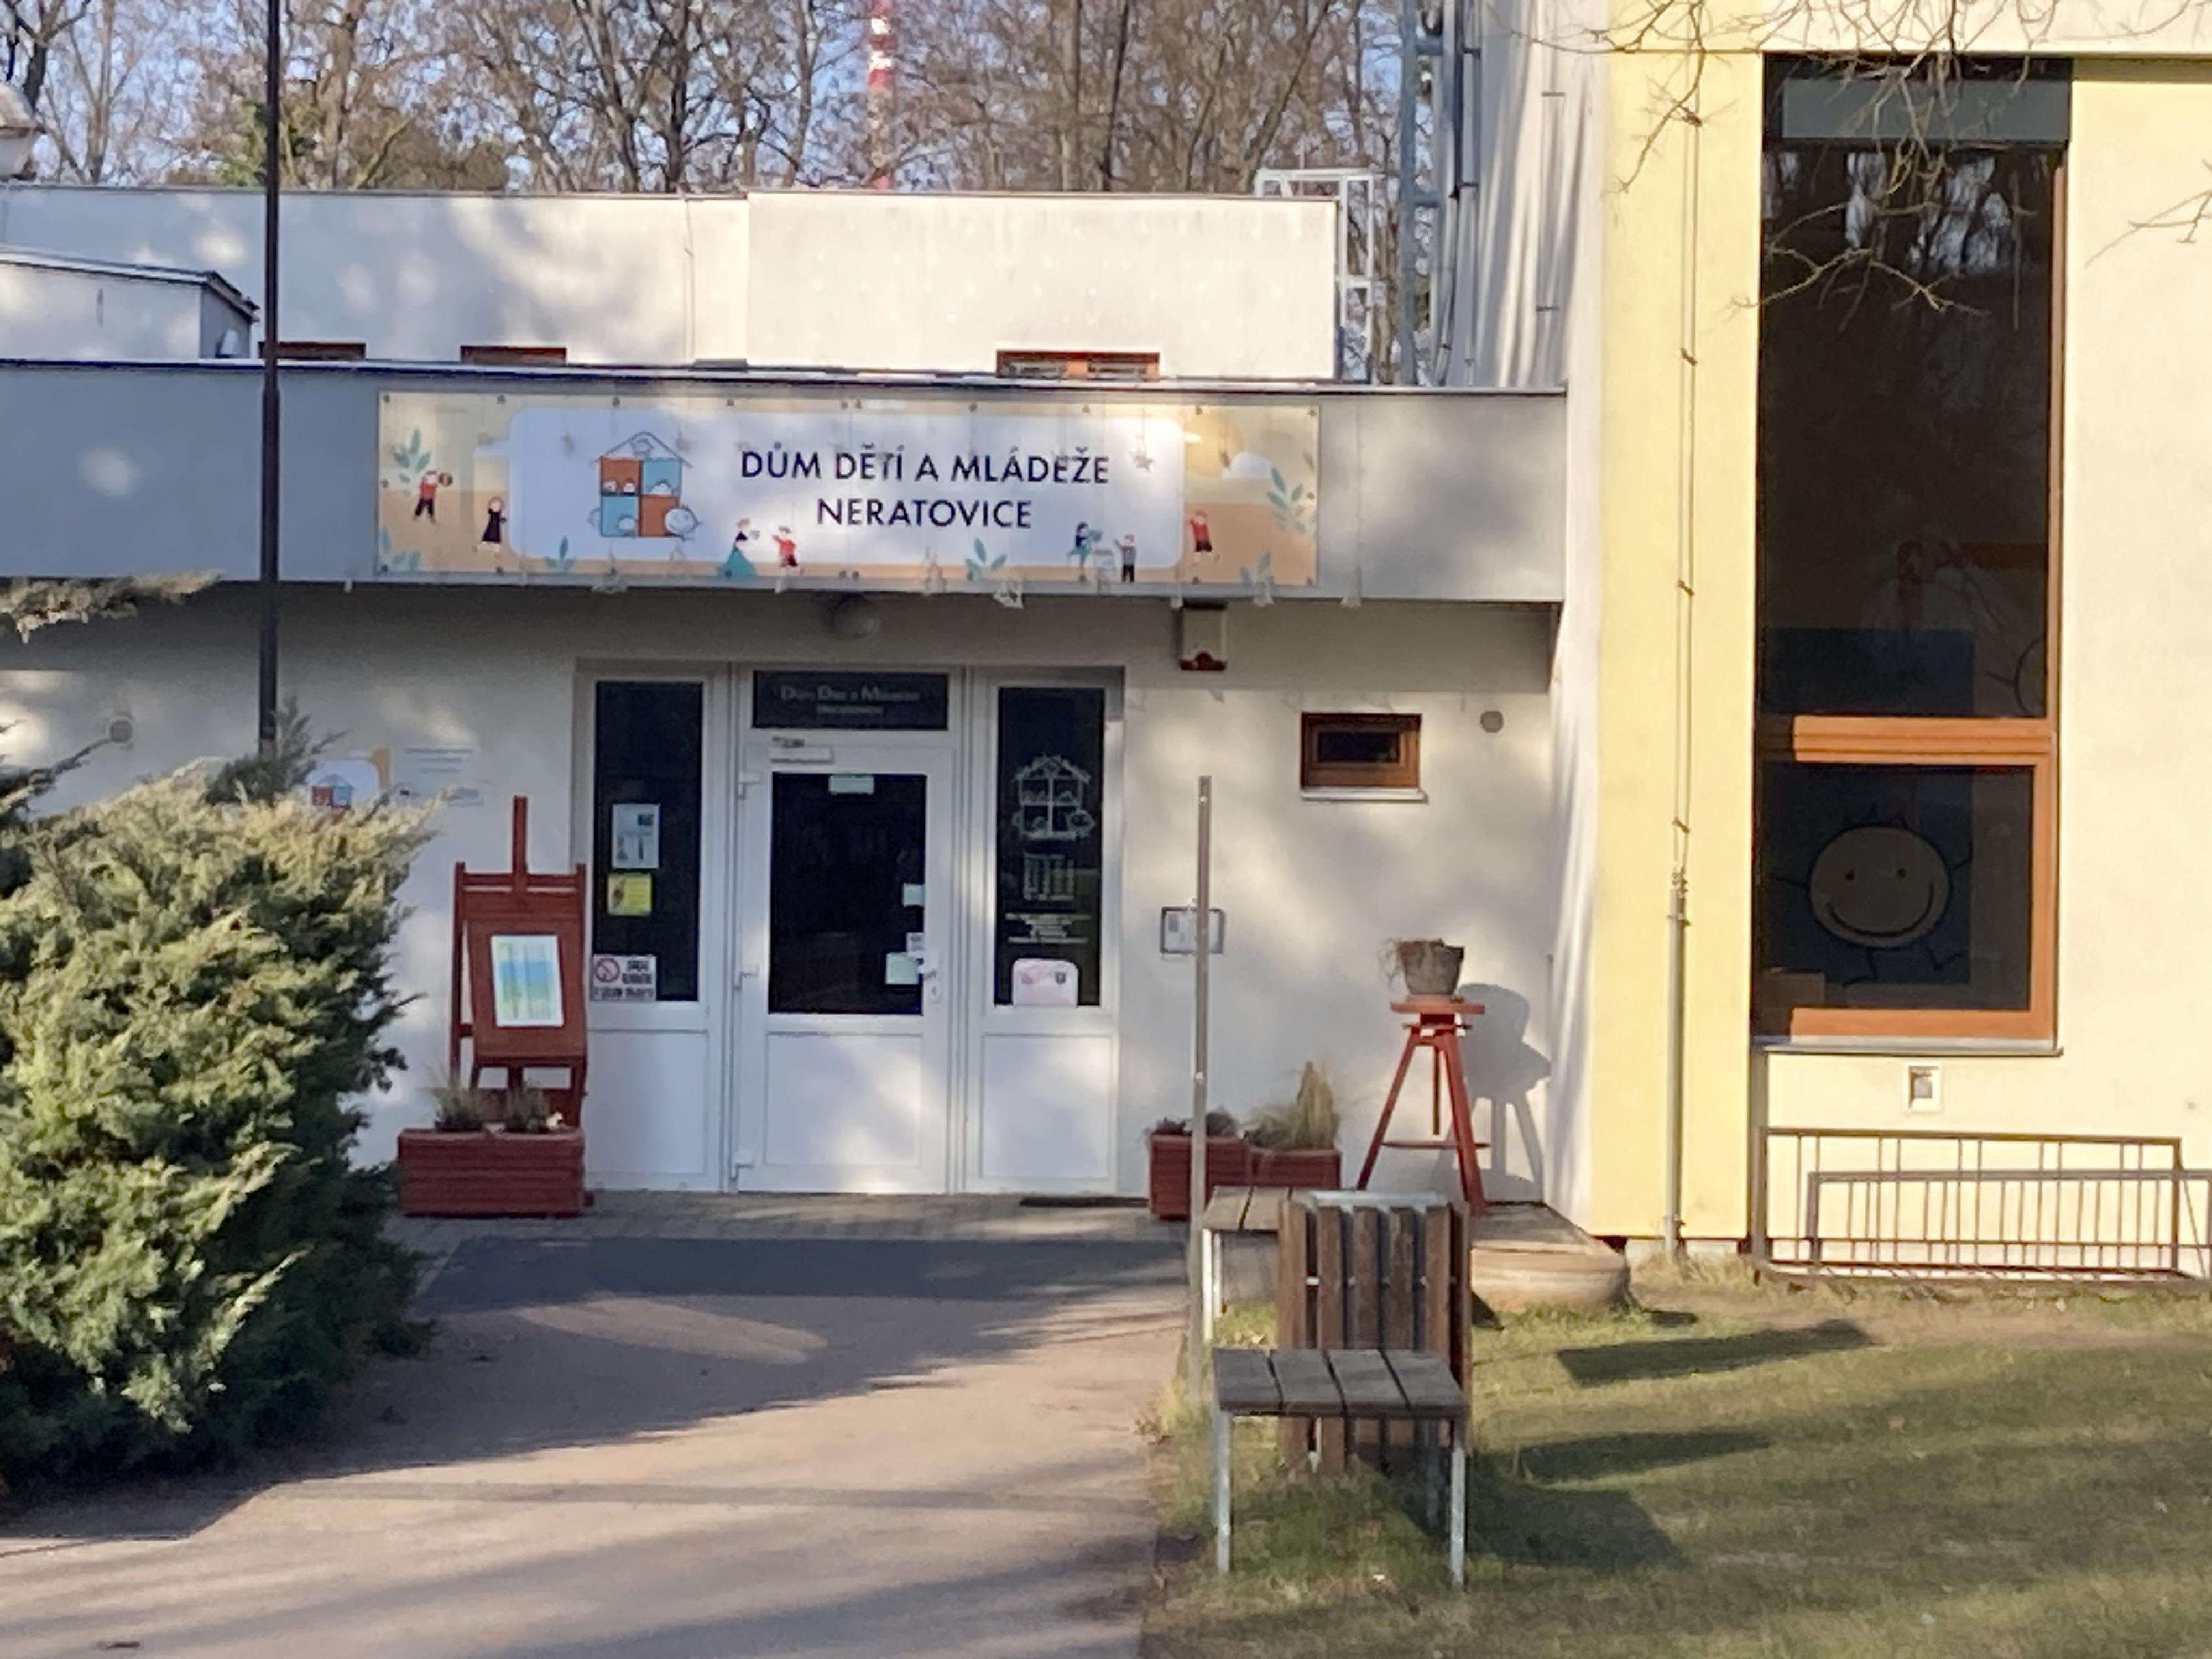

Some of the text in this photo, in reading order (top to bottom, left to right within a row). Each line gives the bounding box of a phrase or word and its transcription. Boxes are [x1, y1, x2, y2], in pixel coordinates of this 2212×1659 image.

[742, 441, 1109, 484] DŮM DĚTÍ A MLÁDEŽE
[817, 498, 1031, 528] NERATOVICE
